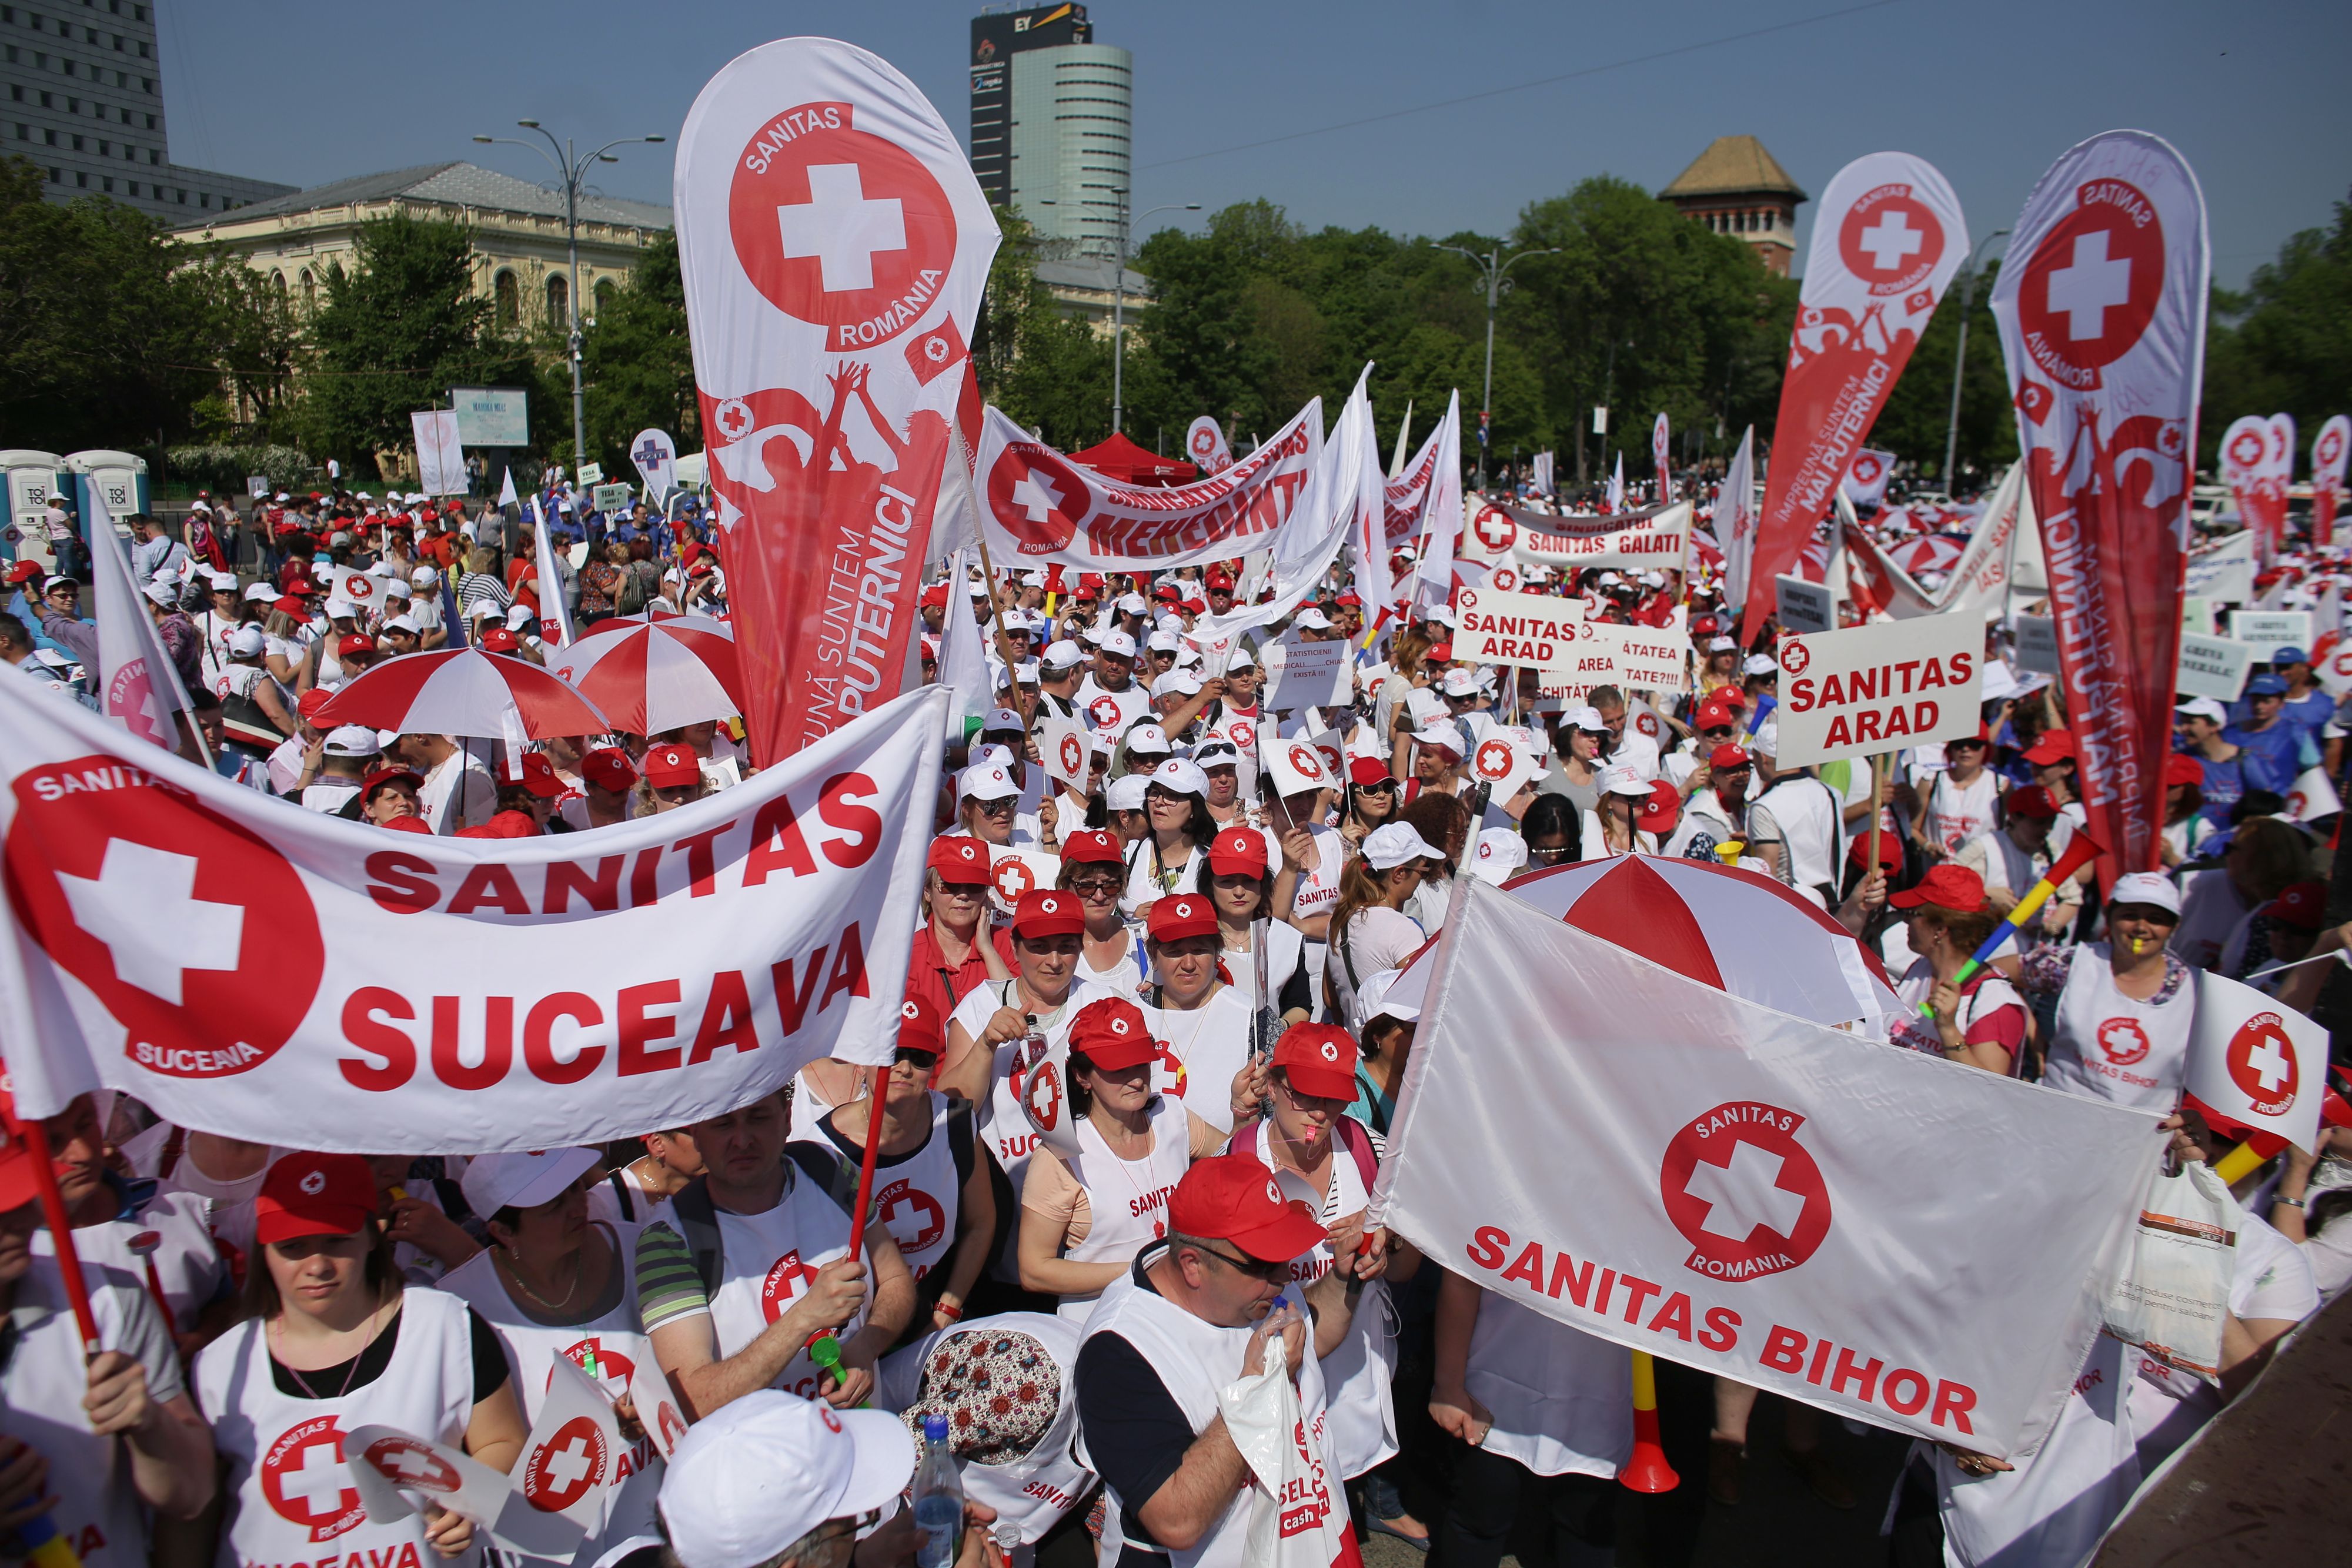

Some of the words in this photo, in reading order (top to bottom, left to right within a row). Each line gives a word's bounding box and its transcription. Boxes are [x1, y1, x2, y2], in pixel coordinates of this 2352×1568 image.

[1014, 16, 1031, 32] EY
[746, 106, 841, 175] SANITAS
[1855, 185, 1907, 213] SANITAS
[1875, 262, 1933, 295] ROMÂNIA
[840, 269, 943, 346] ROMÂNIA
[721, 397, 741, 406] SANITAS
[729, 431, 749, 442] ROMÂNIA
[1799, 470, 1833, 513] MAI
[1822, 358, 1891, 472] PUTERNICI
[1774, 441, 1825, 523] ÎMPREUNĂ
[1819, 375, 1861, 442] SUNTEM
[601, 490, 615, 498] TESA
[1024, 536, 1068, 552] ROMANIA
[1529, 533, 1605, 554] SANITAS
[1619, 534, 1680, 554] GALATI
[818, 526, 866, 667] SUNTEM
[838, 483, 916, 714] PUTERNICI
[1463, 613, 1576, 642] SANITAS
[1285, 648, 1332, 658] STATISTICIENII
[1481, 637, 1553, 661] ARAD
[1623, 640, 1676, 660] ĂTATEA
[1294, 670, 1317, 678] EXISTĂ
[1578, 657, 1614, 672] AREA
[1626, 668, 1678, 685] TATE?!!!
[1789, 653, 1972, 713] SANITAS
[1091, 696, 1110, 706] SANITAS
[1100, 720, 1118, 729] ROMÂNIA
[1422, 711, 1451, 724] SINDICAT
[1823, 701, 1939, 750] ARAD
[1490, 739, 1511, 750] SANITAS
[365, 772, 883, 915] SANITAS
[996, 856, 1020, 867] SANITAS
[1298, 887, 1338, 906] SANITAS
[338, 920, 871, 1093] SUCEAVA
[2247, 1014, 2280, 1031] SANITAS
[135, 1040, 265, 1072] SUCEAVA
[2083, 1057, 2119, 1078] NITAS
[1050, 1065, 1062, 1096] SANITAS
[2257, 1092, 2296, 1114] ROMÂNIA
[1695, 1106, 1793, 1141] SANITAS
[1129, 1185, 1177, 1218] SANITA
[901, 1231, 941, 1253] ROMÂNIA
[2199, 1232, 2220, 1242] SHOP
[765, 1255, 797, 1298] SANITAS
[1289, 1258, 1336, 1282] SANIT
[1691, 1252, 1796, 1280] ROMANIA
[2121, 1278, 2133, 1289] de
[2135, 1283, 2174, 1301] produse
[2144, 1298, 2176, 1313] pentru
[2179, 1306, 2216, 1322] saloane
[1465, 1225, 1743, 1353] SANITAS
[1759, 1324, 1978, 1436] BIHOR
[2071, 1368, 2103, 1395] HOR
[266, 1420, 328, 1467] SANITAS
[527, 1449, 544, 1497] SANITAS
[1023, 1481, 1074, 1510] SANIT
[318, 1502, 368, 1540] ROMÂN
[1284, 1509, 1314, 1530] cash
